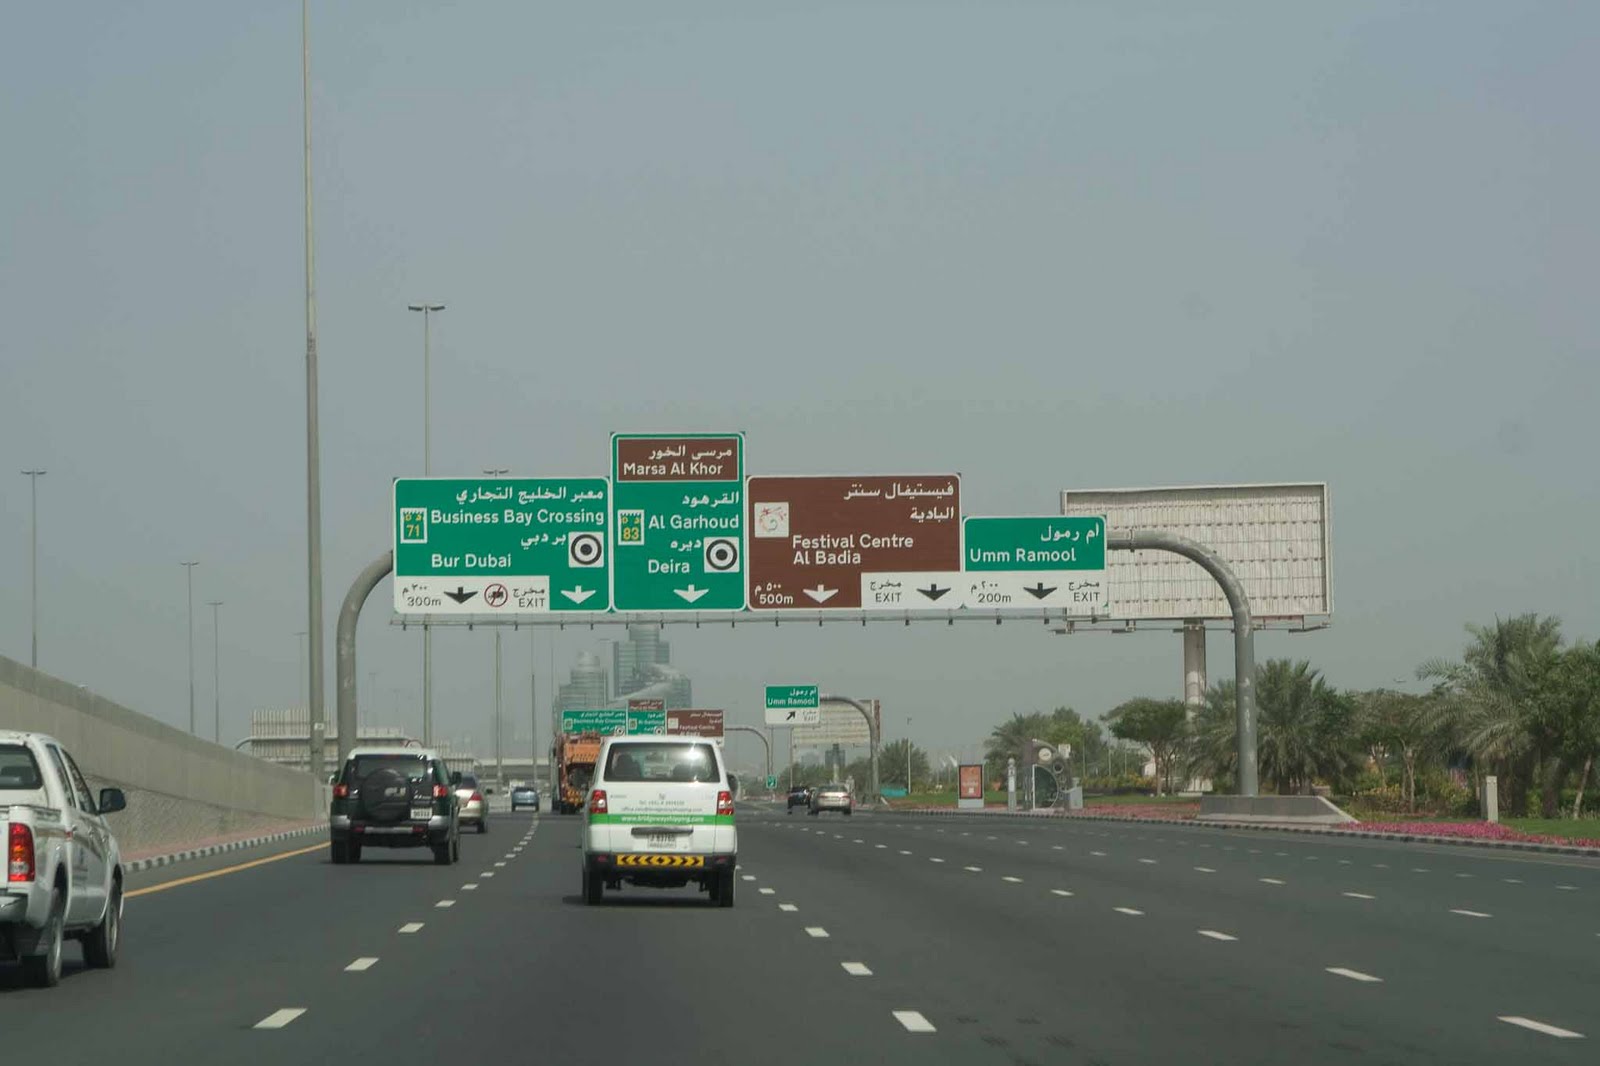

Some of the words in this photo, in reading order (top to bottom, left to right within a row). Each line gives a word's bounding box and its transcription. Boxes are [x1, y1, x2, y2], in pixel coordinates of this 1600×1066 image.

[648, 445, 686, 460] الخور
[691, 447, 732, 460] مرسى
[623, 462, 666, 475] Marsa
[670, 462, 686, 475] Al
[689, 462, 723, 475] Khor
[456, 487, 513, 505] التجاري
[518, 486, 566, 504] الخليج
[570, 488, 604, 502] معبر
[843, 484, 881, 500] سنتر
[885, 481, 954, 500] فيستيفال
[431, 509, 499, 524] Business
[504, 509, 533, 526] Bay
[537, 508, 604, 525] Crossing
[648, 515, 665, 529] Al
[670, 514, 739, 529] Garhoud
[910, 506, 954, 523] البادية
[406, 524, 420, 537] 71
[623, 527, 639, 540] 83
[1040, 525, 1080, 542] رمول
[520, 533, 548, 548] دبي
[552, 534, 566, 545] بر
[792, 534, 855, 549] Festival
[859, 534, 914, 548] Centre
[431, 554, 460, 568] Bur
[465, 553, 511, 568] Dubai
[793, 551, 810, 565] Al
[815, 551, 861, 565] Badia
[970, 548, 1010, 563] Umm
[1016, 547, 1076, 562] Ramool
[648, 559, 690, 573] Deira
[870, 581, 902, 591] مخرج
[1068, 579, 1100, 591] مخرج
[512, 587, 545, 598] مخرج
[759, 594, 794, 605] 500m
[875, 593, 902, 603] EXIT
[978, 593, 1011, 603] 200m
[1073, 592, 1100, 602] EXIT
[407, 596, 441, 607] 300m
[518, 598, 545, 608] EXIT
[767, 697, 786, 706] Umm
[787, 697, 815, 706] Ramool
